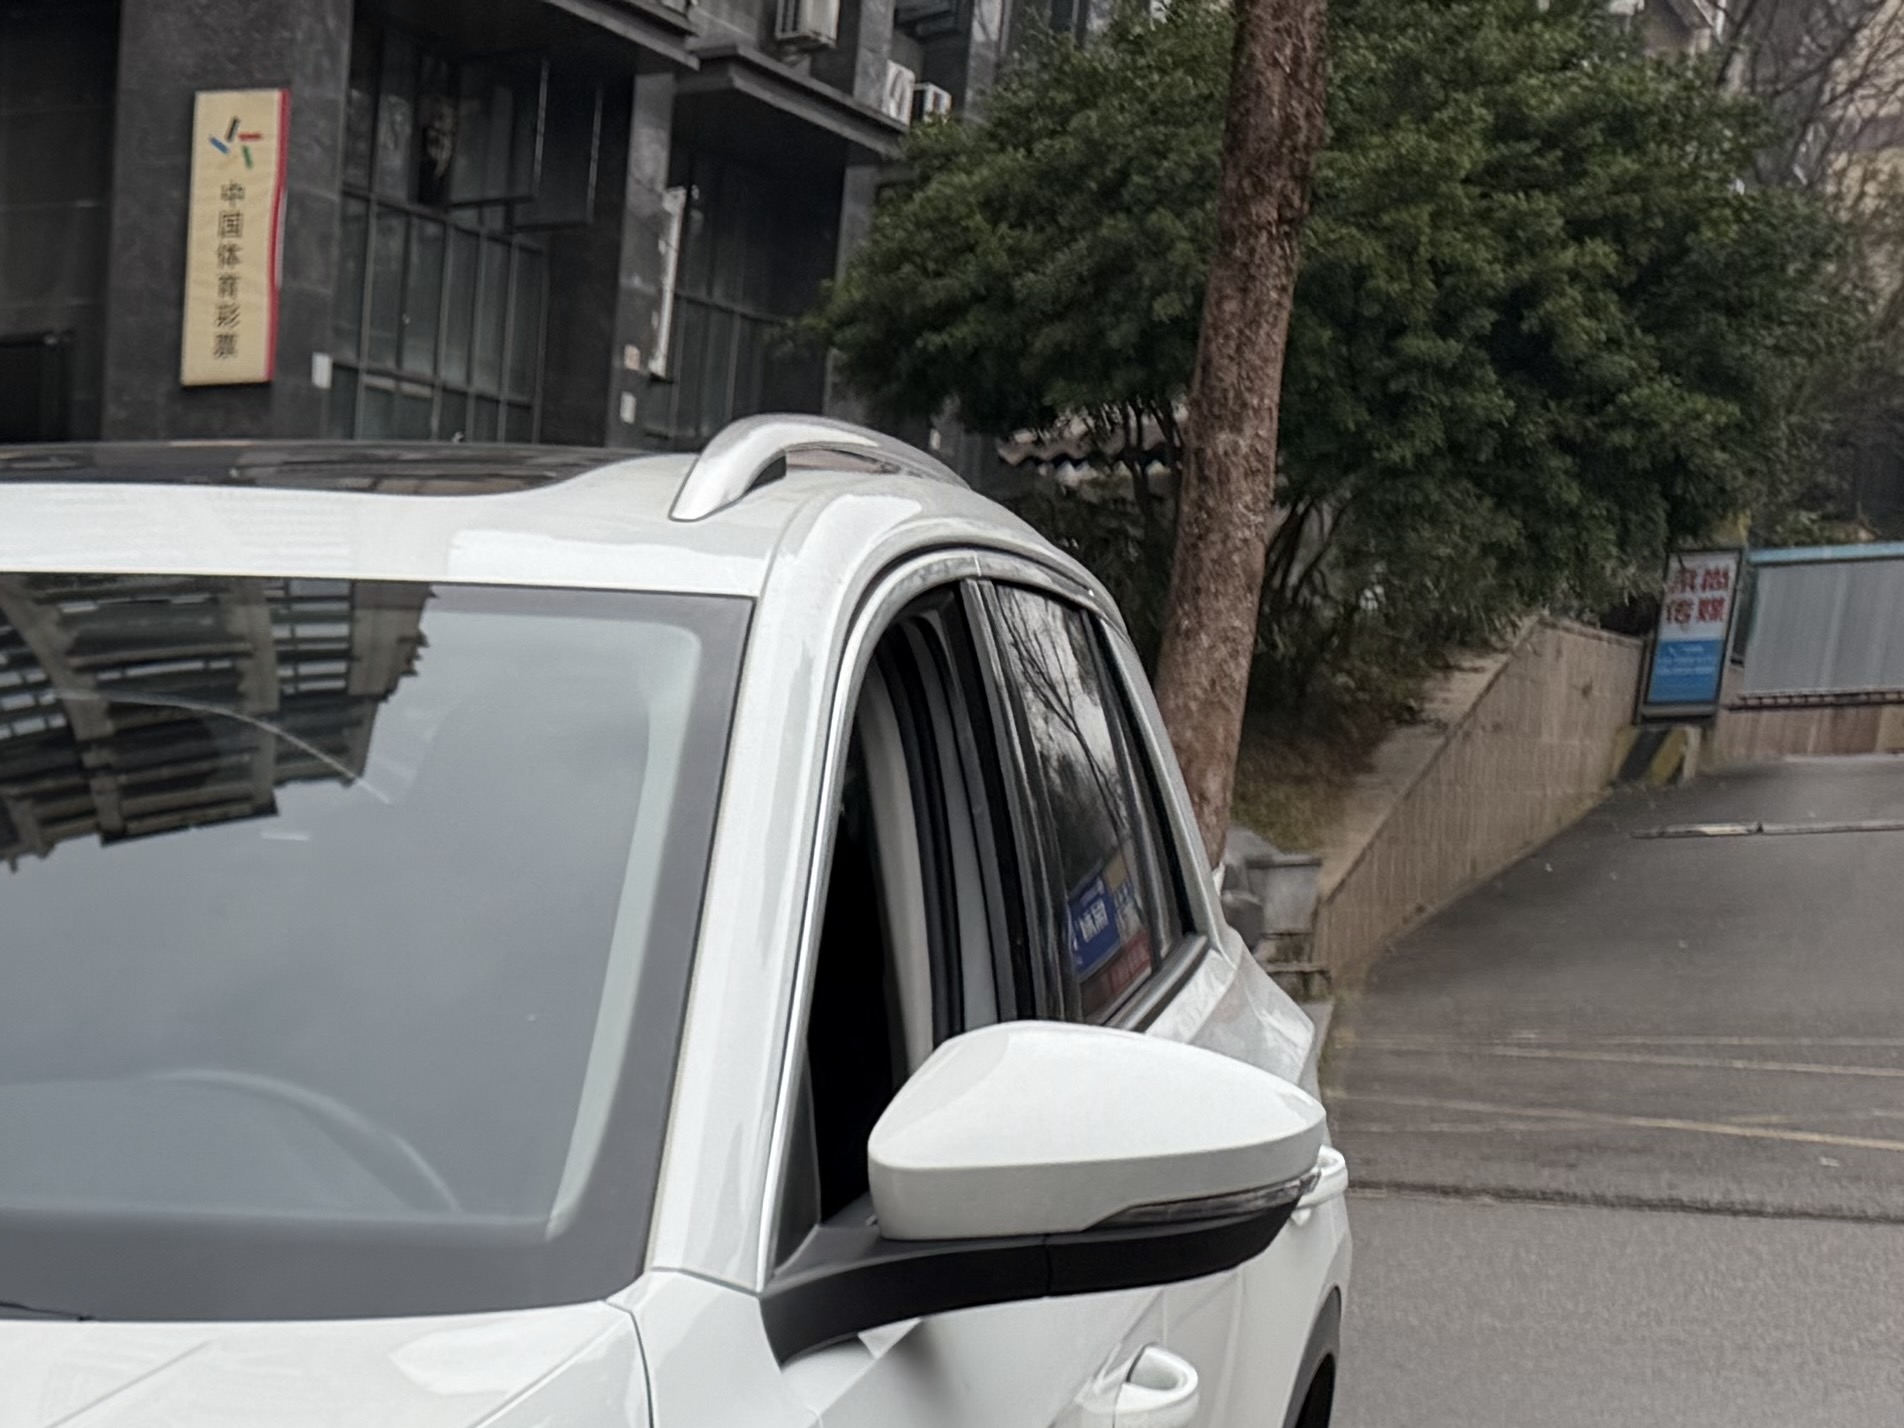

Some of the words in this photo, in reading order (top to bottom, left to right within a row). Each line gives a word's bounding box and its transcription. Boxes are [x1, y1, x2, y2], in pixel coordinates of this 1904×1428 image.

[214, 179, 246, 361] 中国体育彩票
